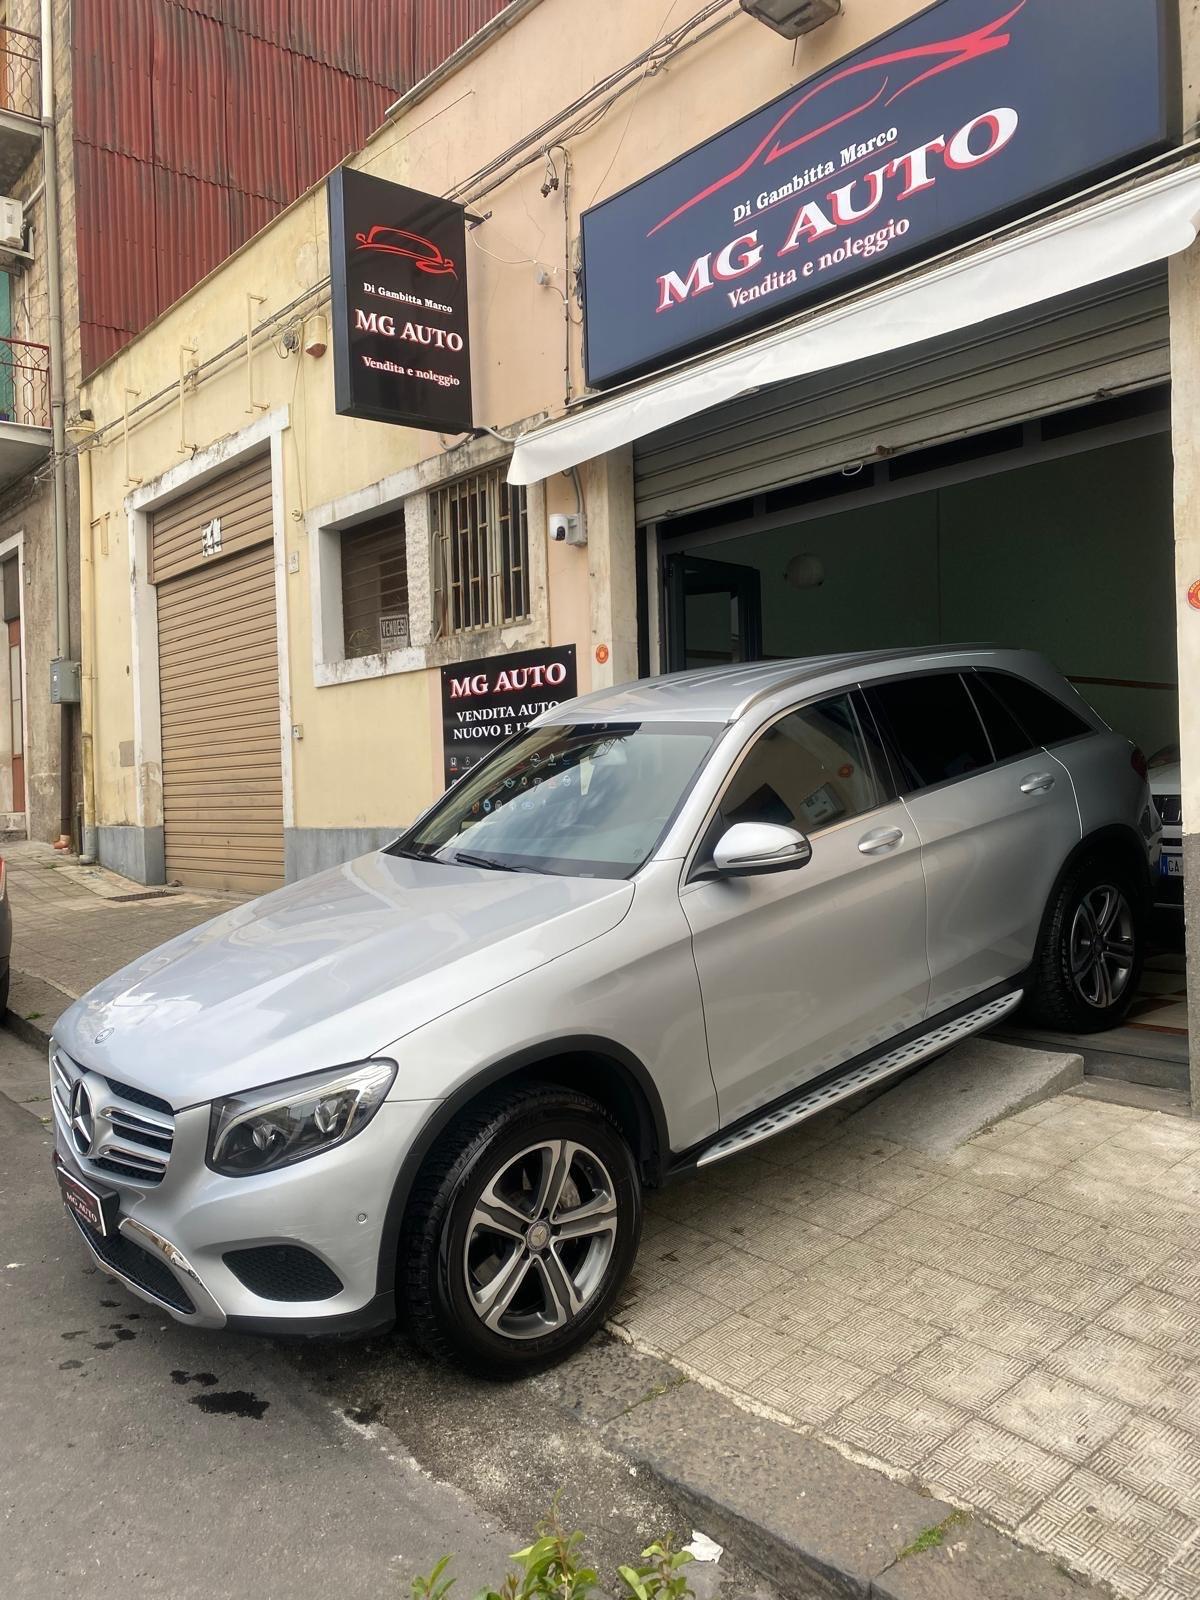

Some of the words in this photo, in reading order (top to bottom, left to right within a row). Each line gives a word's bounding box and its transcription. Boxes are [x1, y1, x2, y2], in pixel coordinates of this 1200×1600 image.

[733, 201, 752, 223] Di
[756, 160, 835, 210] Gambitta
[840, 127, 899, 167] Marco
[656, 230, 764, 313] MG
[777, 107, 1019, 257] AUTO
[728, 268, 798, 308] Vendita
[802, 261, 814, 277] e
[818, 218, 911, 273] noleggio
[363, 282, 376, 294] Di
[378, 286, 422, 306] Gambitta
[424, 297, 453, 313] Marco
[354, 308, 396, 336] MG
[400, 323, 464, 351] AUTO
[361, 355, 405, 375] Vendita
[407, 367, 414, 376] e
[416, 369, 460, 387] noleggio
[450, 673, 489, 698] MG
[493, 662, 567, 692] AUTO
[453, 725, 501, 740] NUOVO
[504, 723, 513, 735] E
[456, 706, 516, 722] VENDITA
